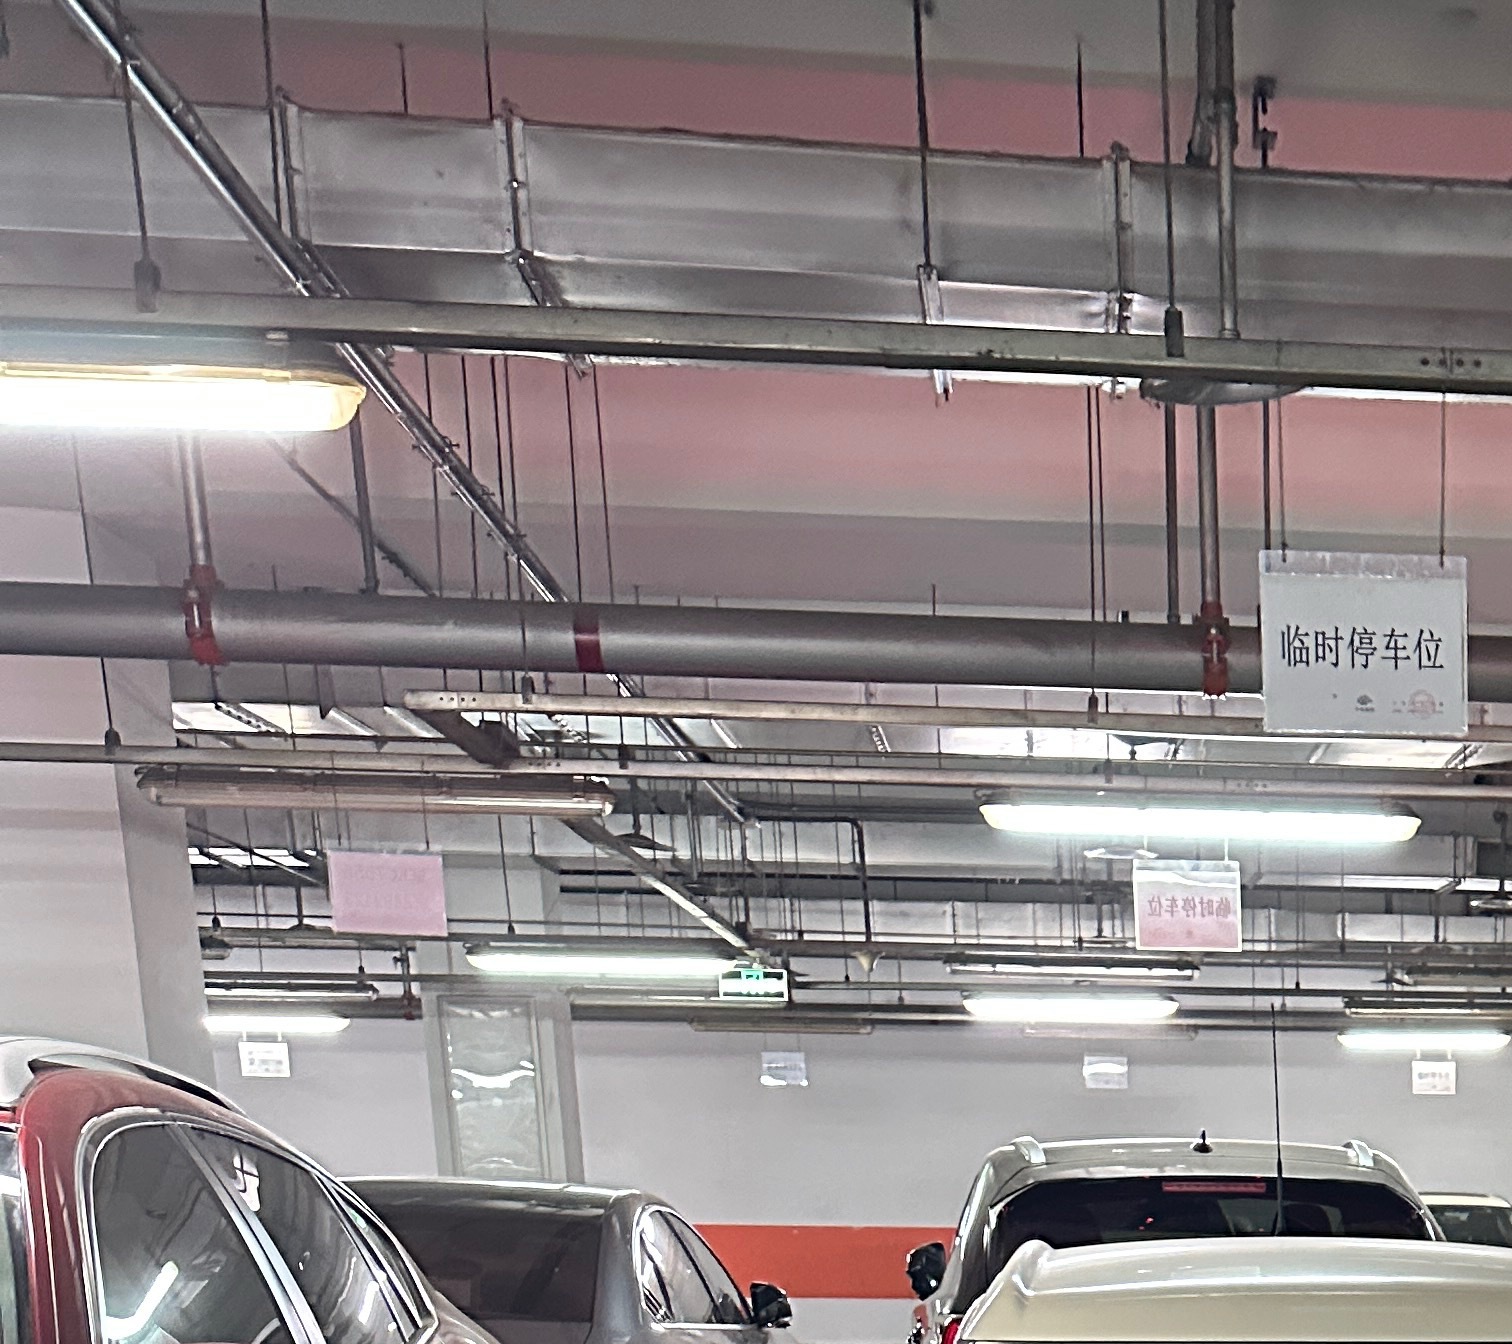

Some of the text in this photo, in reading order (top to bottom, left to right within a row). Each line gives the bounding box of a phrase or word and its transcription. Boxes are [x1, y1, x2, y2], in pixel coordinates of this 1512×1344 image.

[1281, 624, 1444, 671] 临时停车位
